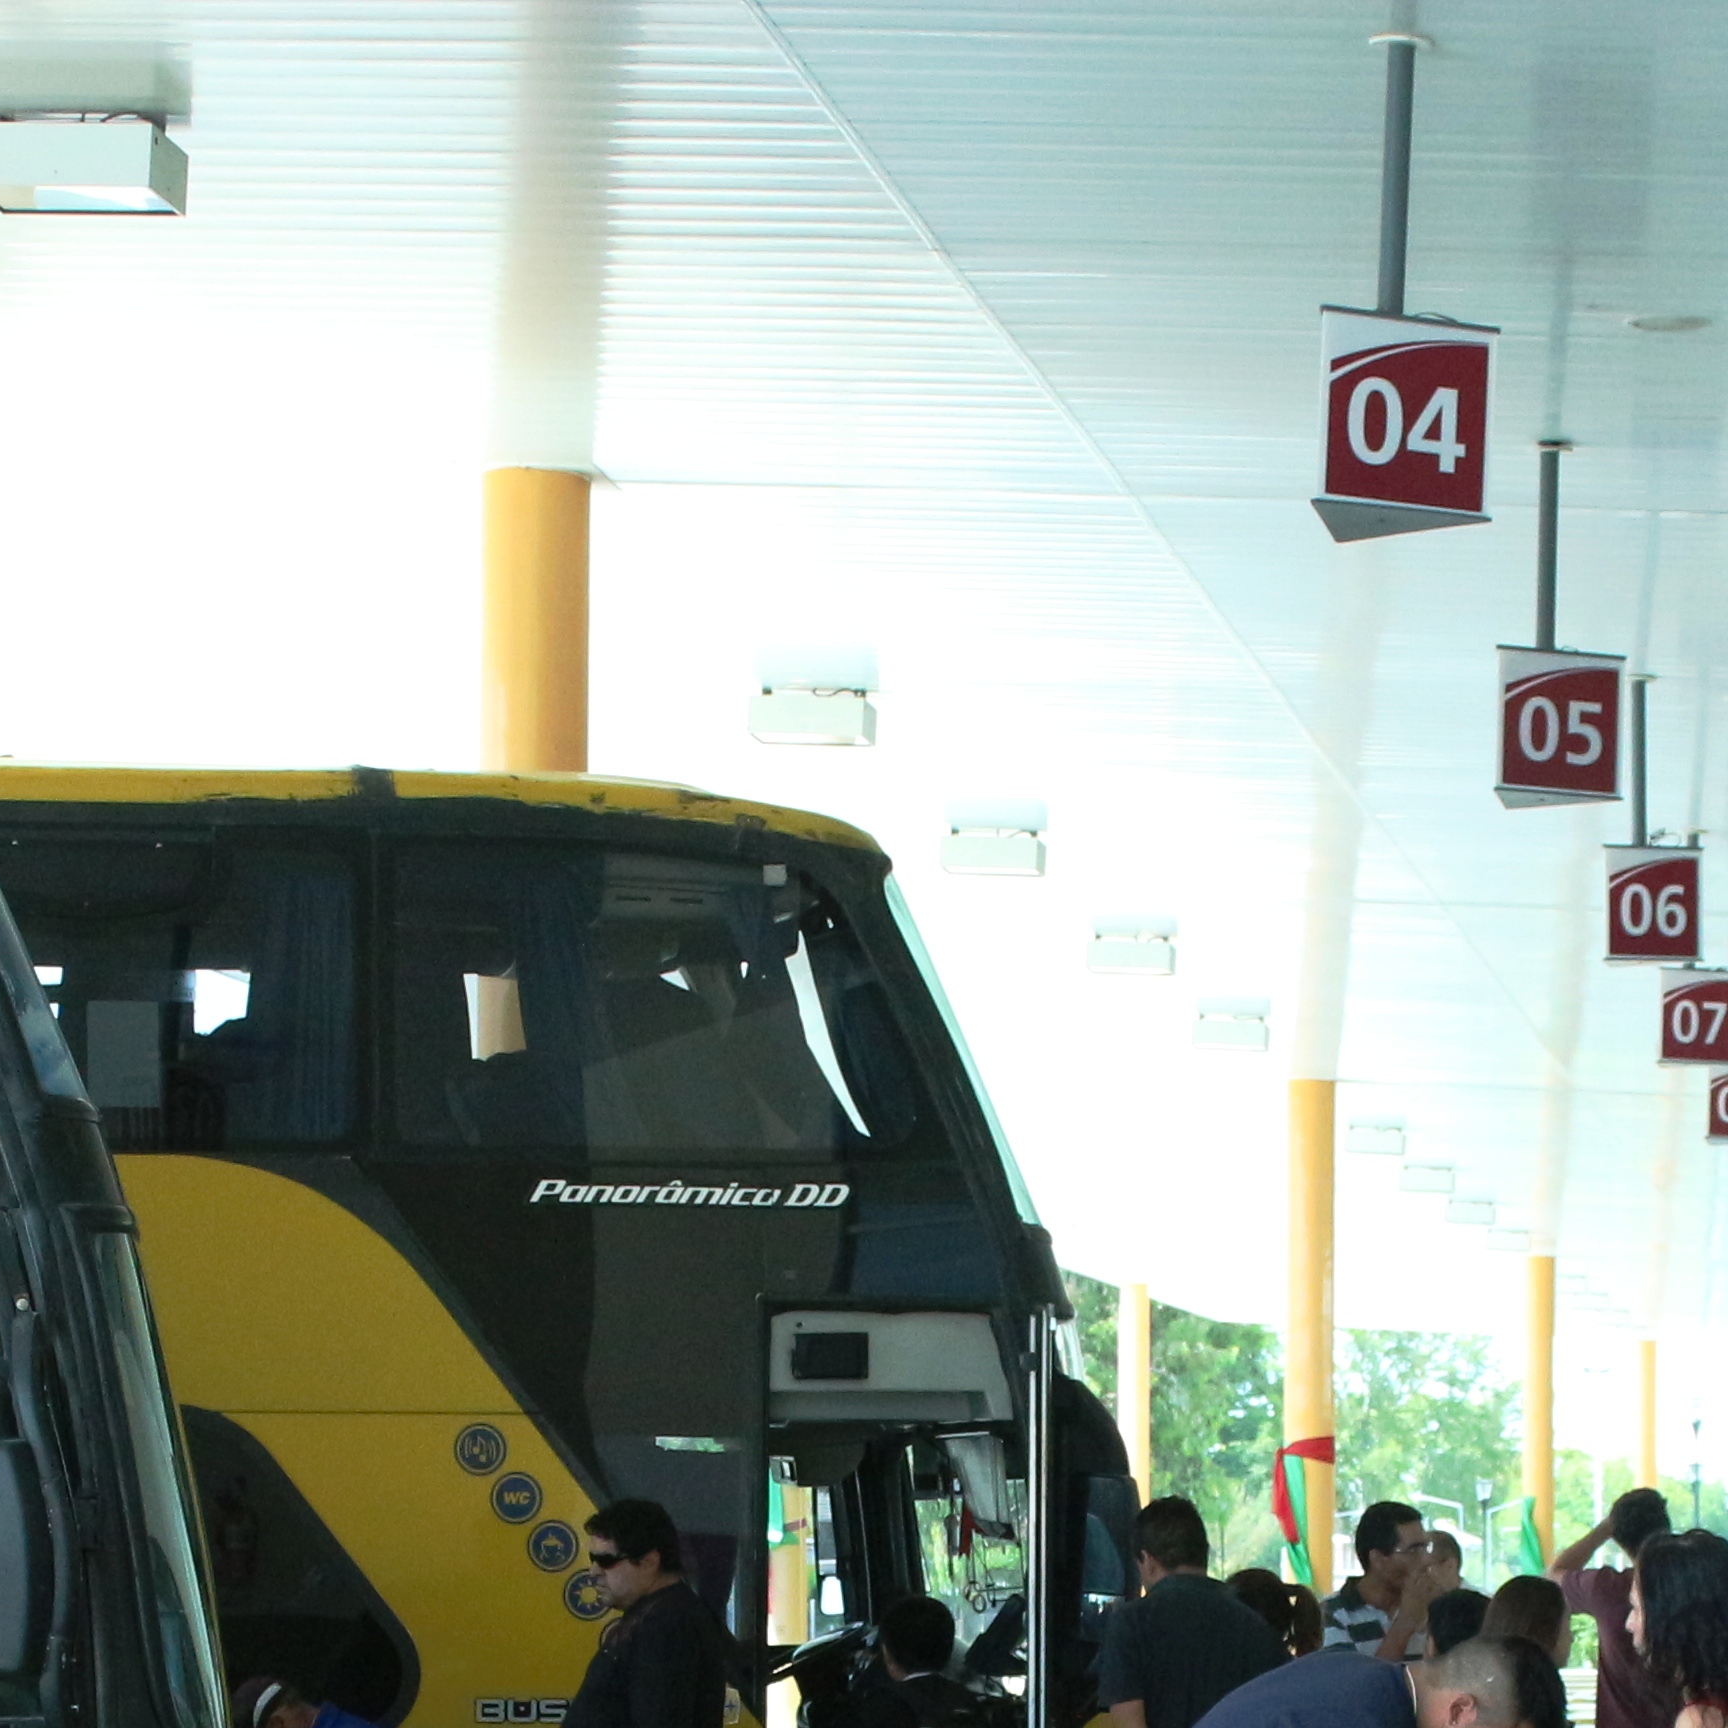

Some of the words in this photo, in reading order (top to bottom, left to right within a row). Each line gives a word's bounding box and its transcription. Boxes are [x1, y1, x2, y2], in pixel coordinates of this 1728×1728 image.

[1347, 377, 1466, 474] 04
[1518, 696, 1603, 767] 05
[1619, 883, 1688, 937] 06
[1671, 1000, 1728, 1045] 07
[783, 1183, 851, 1208] DD
[502, 1490, 532, 1505] WC
